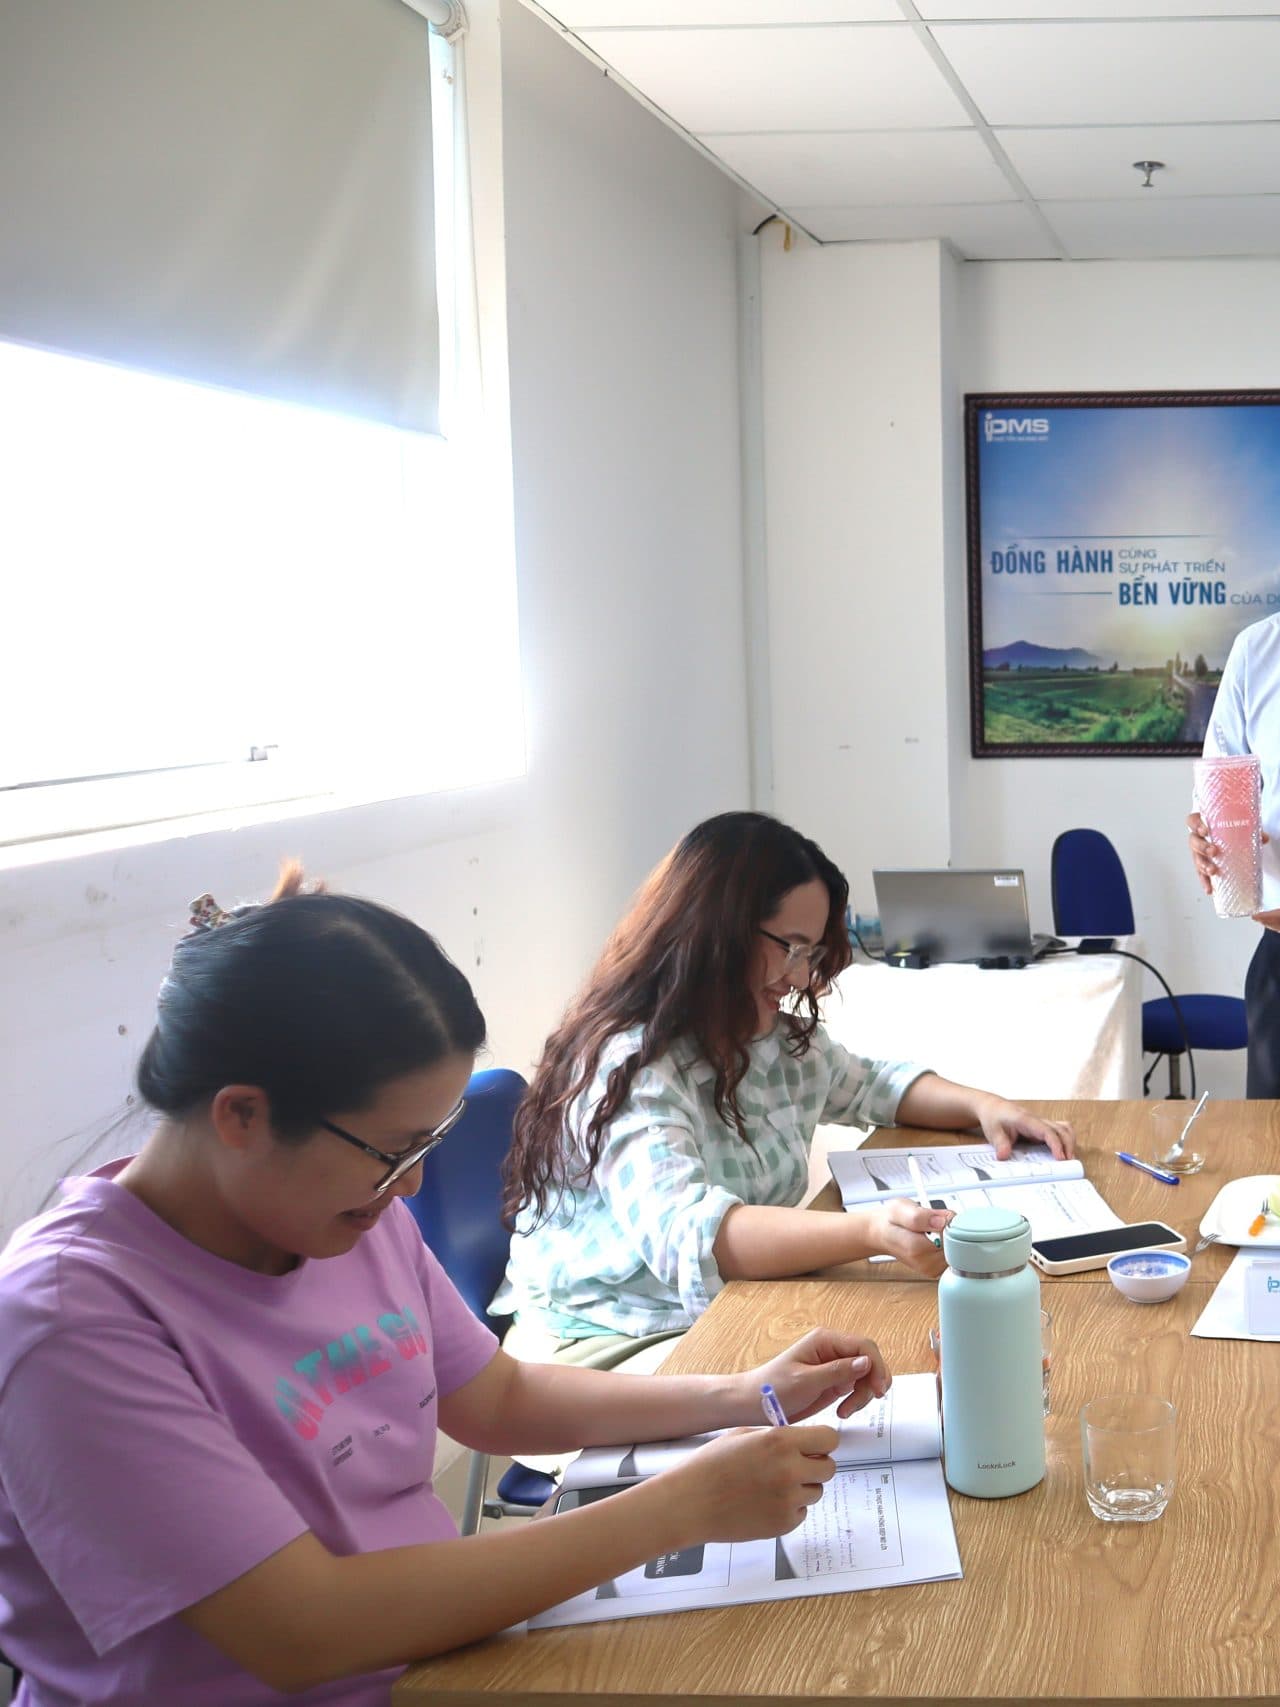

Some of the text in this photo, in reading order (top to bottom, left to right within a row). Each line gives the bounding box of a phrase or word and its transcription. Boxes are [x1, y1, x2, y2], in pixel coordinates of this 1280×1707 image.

[1057, 545, 1113, 574] HÀNH
[1143, 558, 1180, 573] PHÁT
[1169, 576, 1227, 605] VỮNG
